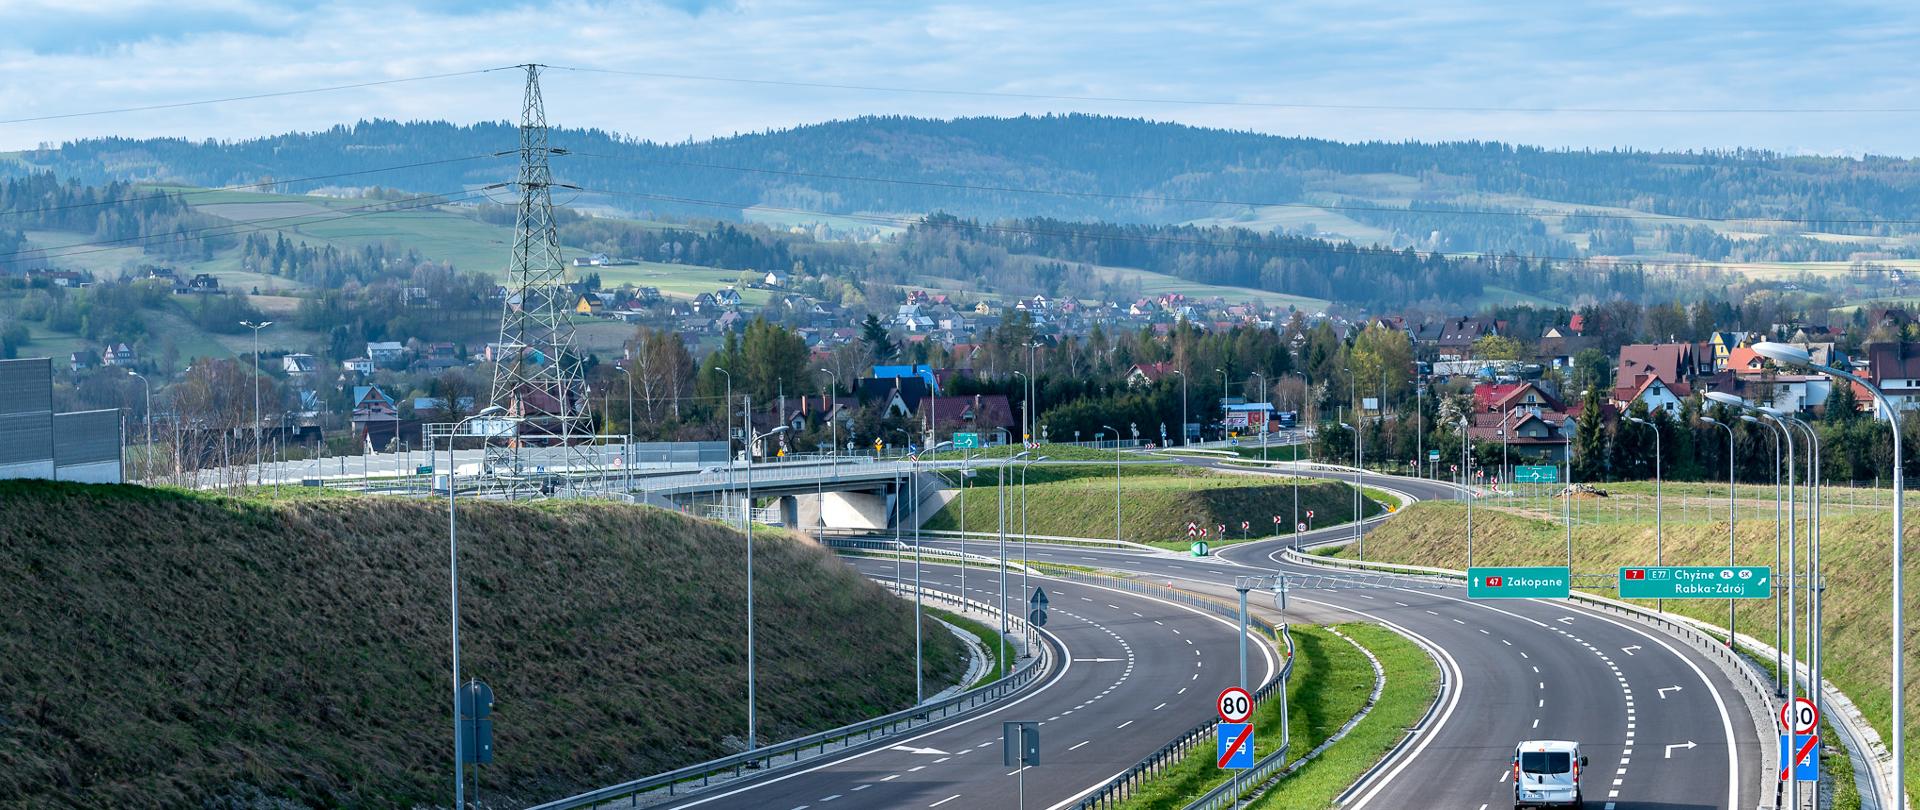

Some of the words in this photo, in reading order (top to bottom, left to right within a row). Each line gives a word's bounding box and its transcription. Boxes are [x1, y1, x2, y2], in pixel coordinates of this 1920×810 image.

[1674, 570, 1715, 582] Chyżne
[1507, 577, 1563, 589] Zakopane
[1675, 583, 1745, 595] Rabka-Zdrój
[1223, 697, 1248, 714] 80
